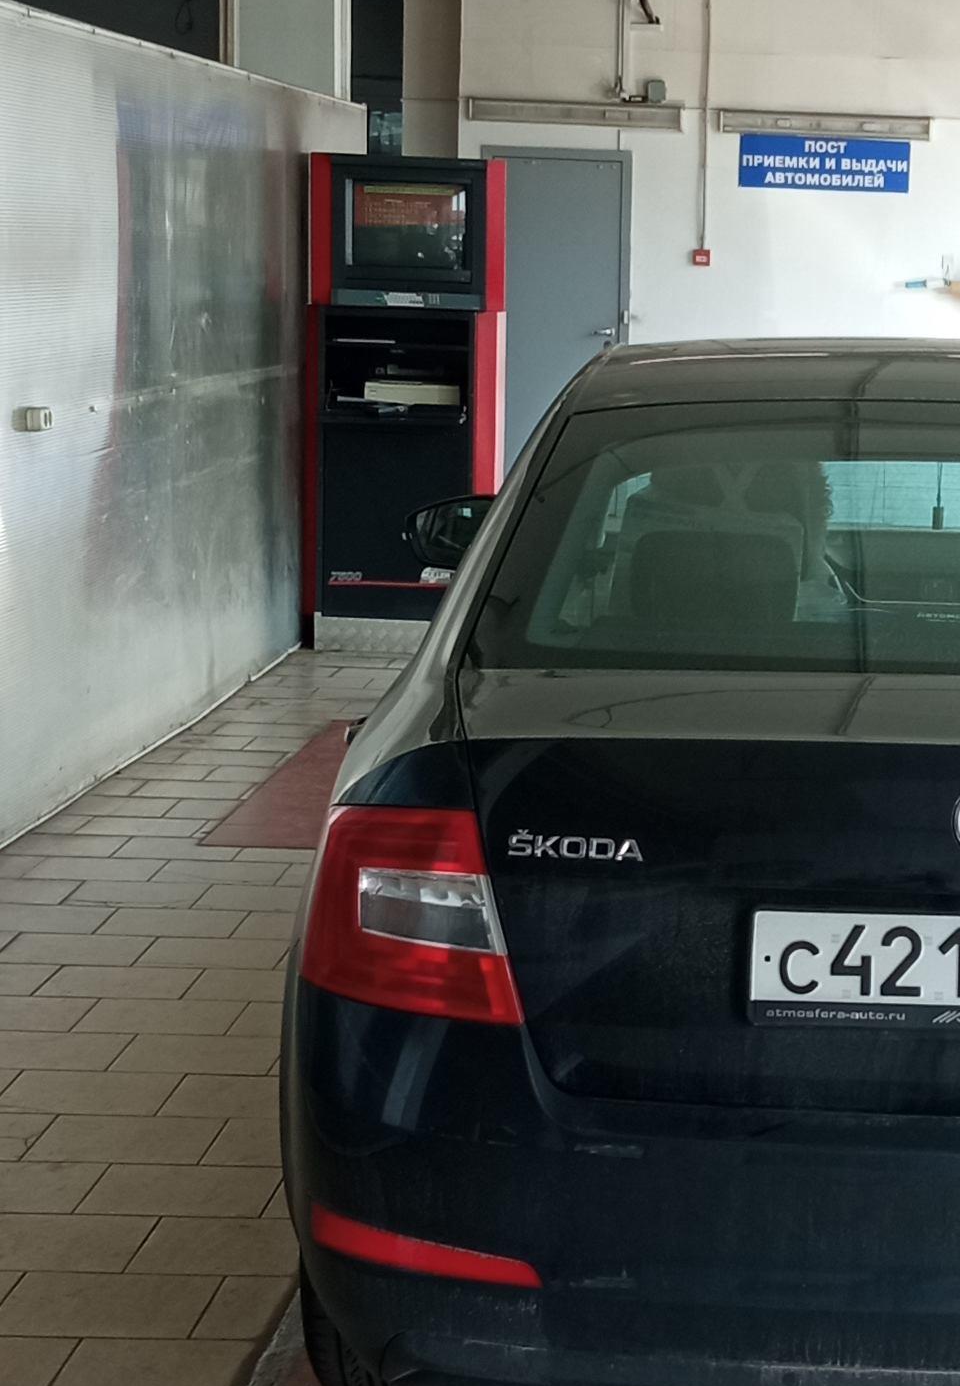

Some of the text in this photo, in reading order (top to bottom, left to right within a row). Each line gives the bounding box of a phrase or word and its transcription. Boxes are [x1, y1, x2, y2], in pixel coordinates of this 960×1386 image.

[804, 140, 847, 153] ПОСТ
[742, 154, 908, 173] ПРИЕМКИ И ВЫДАЧИ
[764, 171, 885, 188] АВТОМОБИЛЕЙ
[508, 829, 643, 861] ŠKODA
[766, 1008, 906, 1021] atmosfera-auto.ru
